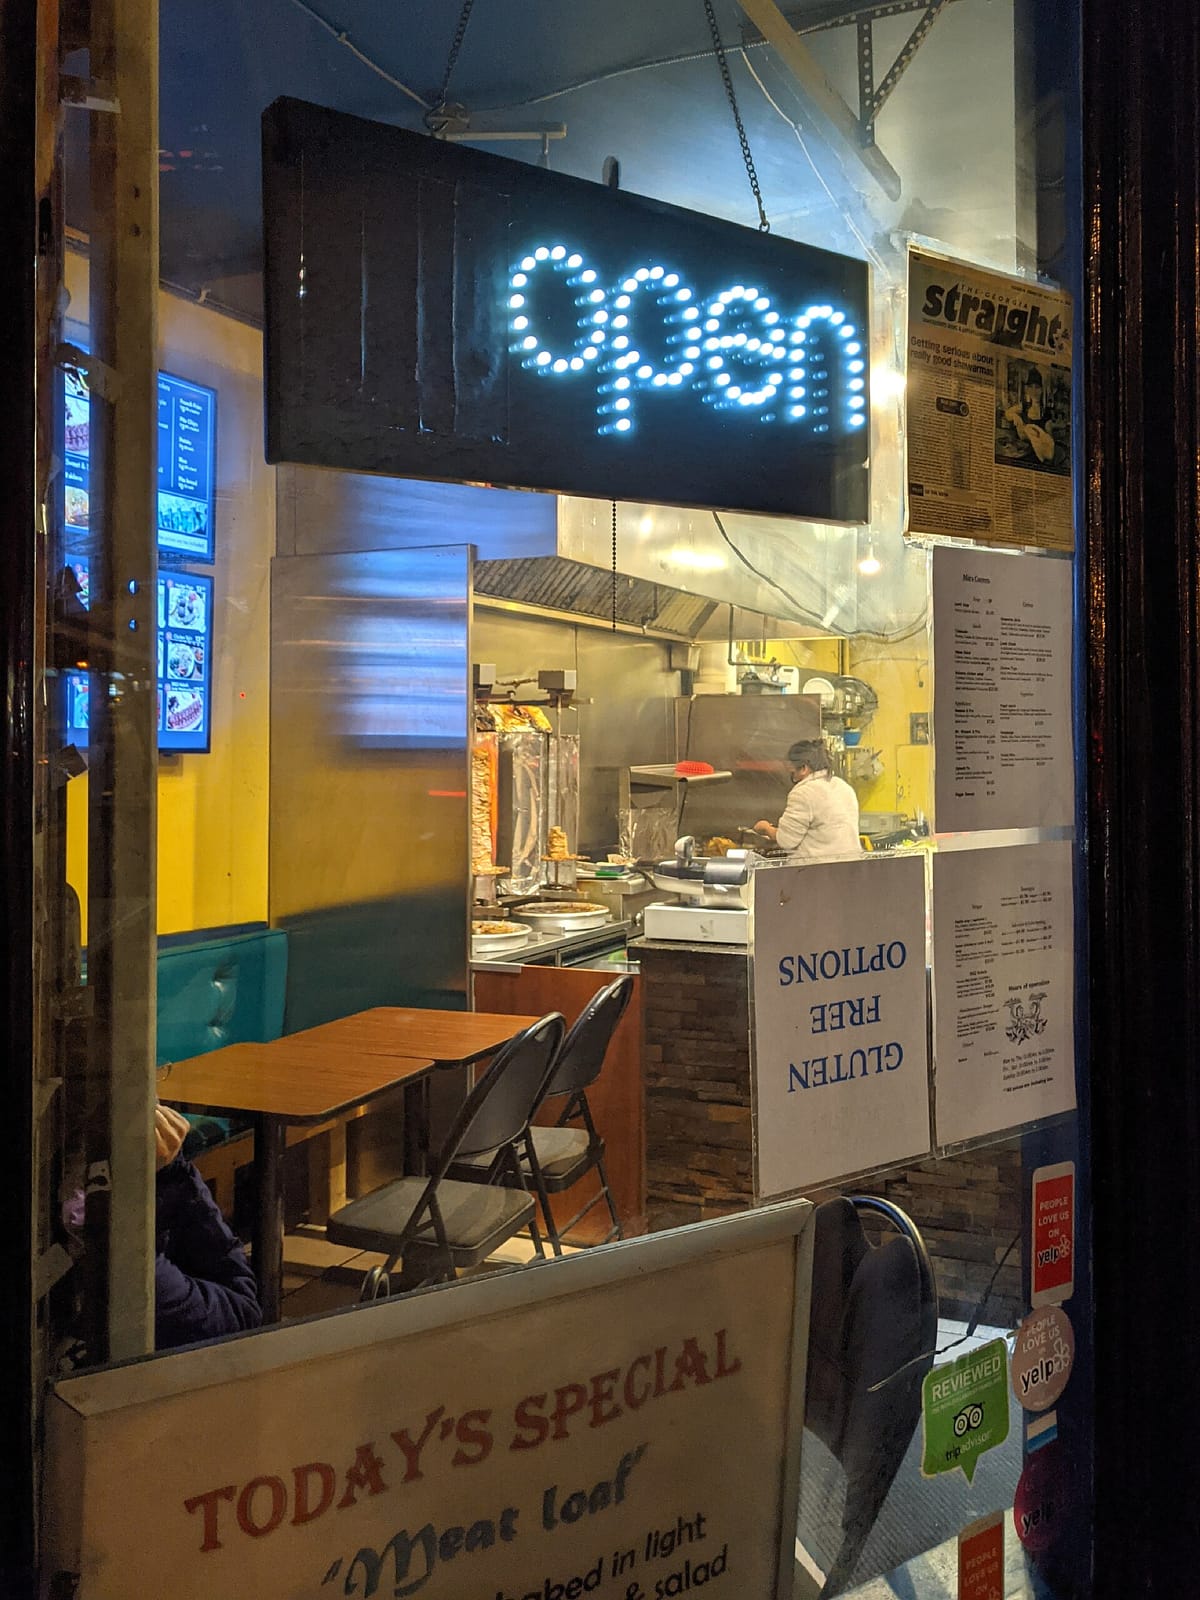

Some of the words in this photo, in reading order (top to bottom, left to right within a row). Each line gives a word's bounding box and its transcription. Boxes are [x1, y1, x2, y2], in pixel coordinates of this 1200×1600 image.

[961, 284, 978, 294] THE
[922, 282, 1061, 350] straight
[507, 245, 866, 433] open
[911, 336, 941, 354] Getting
[933, 352, 951, 367] good
[779, 941, 907, 986] OPTIONS
[810, 995, 881, 1034] FREE
[787, 1042, 904, 1093] GLUTEN
[1038, 1213, 1058, 1226] LOVE
[1059, 1210, 1070, 1221] US
[1039, 1196, 1068, 1211] PEOPLE
[1048, 1228, 1060, 1238] ON
[1037, 1246, 1060, 1267] yelp
[1022, 1332, 1047, 1353] LOVE
[1048, 1325, 1060, 1340] US
[932, 1355, 1001, 1402] REVIEWED
[1020, 1358, 1055, 1394] yelp
[184, 1405, 493, 1554] TODAY'S
[509, 1328, 742, 1451] SPECIAL
[611, 1549, 636, 1577] in
[644, 1511, 707, 1562] light
[655, 1544, 729, 1600] salad
